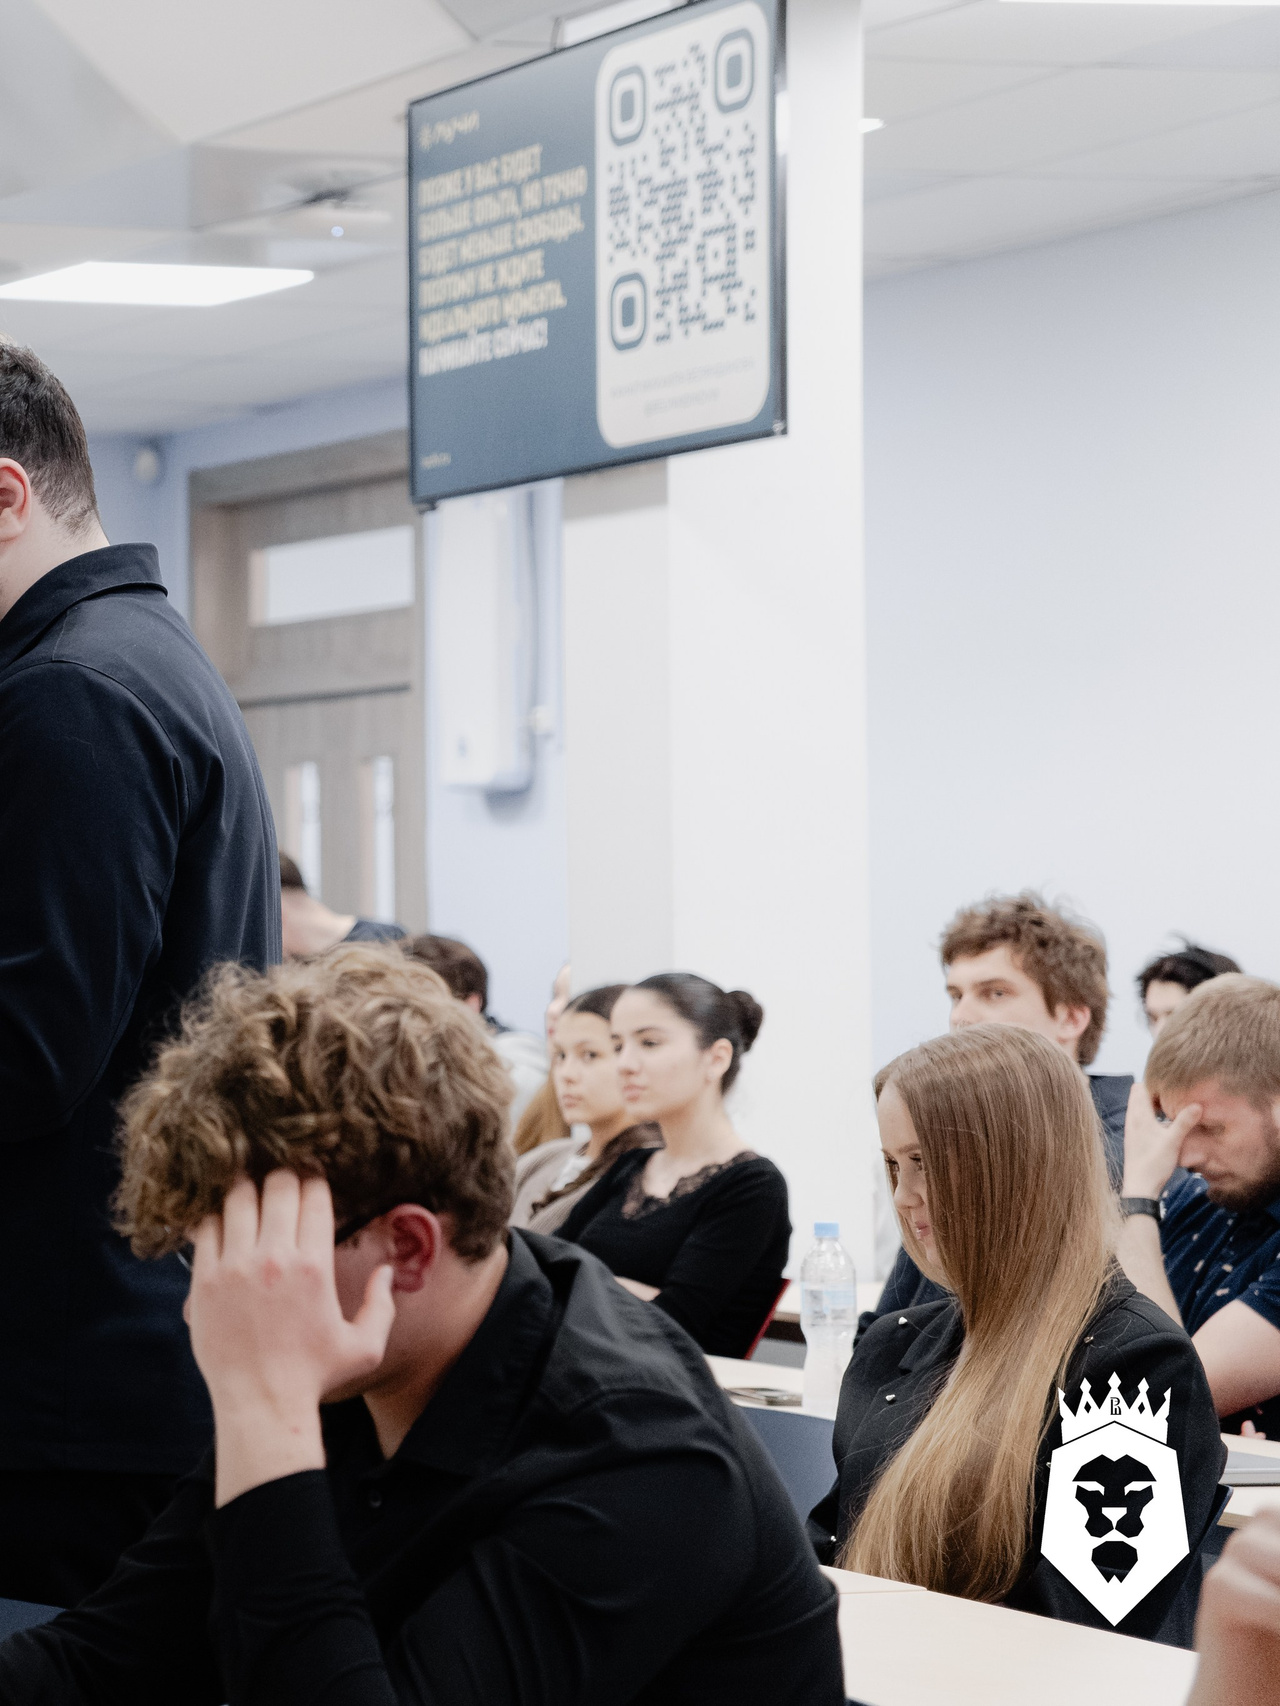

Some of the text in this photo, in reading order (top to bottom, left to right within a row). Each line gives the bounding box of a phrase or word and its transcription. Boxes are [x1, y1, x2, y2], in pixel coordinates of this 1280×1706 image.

[473, 157, 499, 191] ВАС
[501, 143, 542, 184] БУДЕТ
[418, 165, 587, 241] БОЛЬШЕ ОПЫТА, НО ТОЧНО
[418, 238, 459, 278] БУДЕТ
[460, 222, 513, 264] МЕНЬШЕ
[418, 248, 544, 309] ПОЭТОМУ НЕ ЖДИТЕ
[418, 297, 500, 344] ИДЕАЛЬНОГО
[418, 331, 492, 377] НАЧИНАЙТЕ
